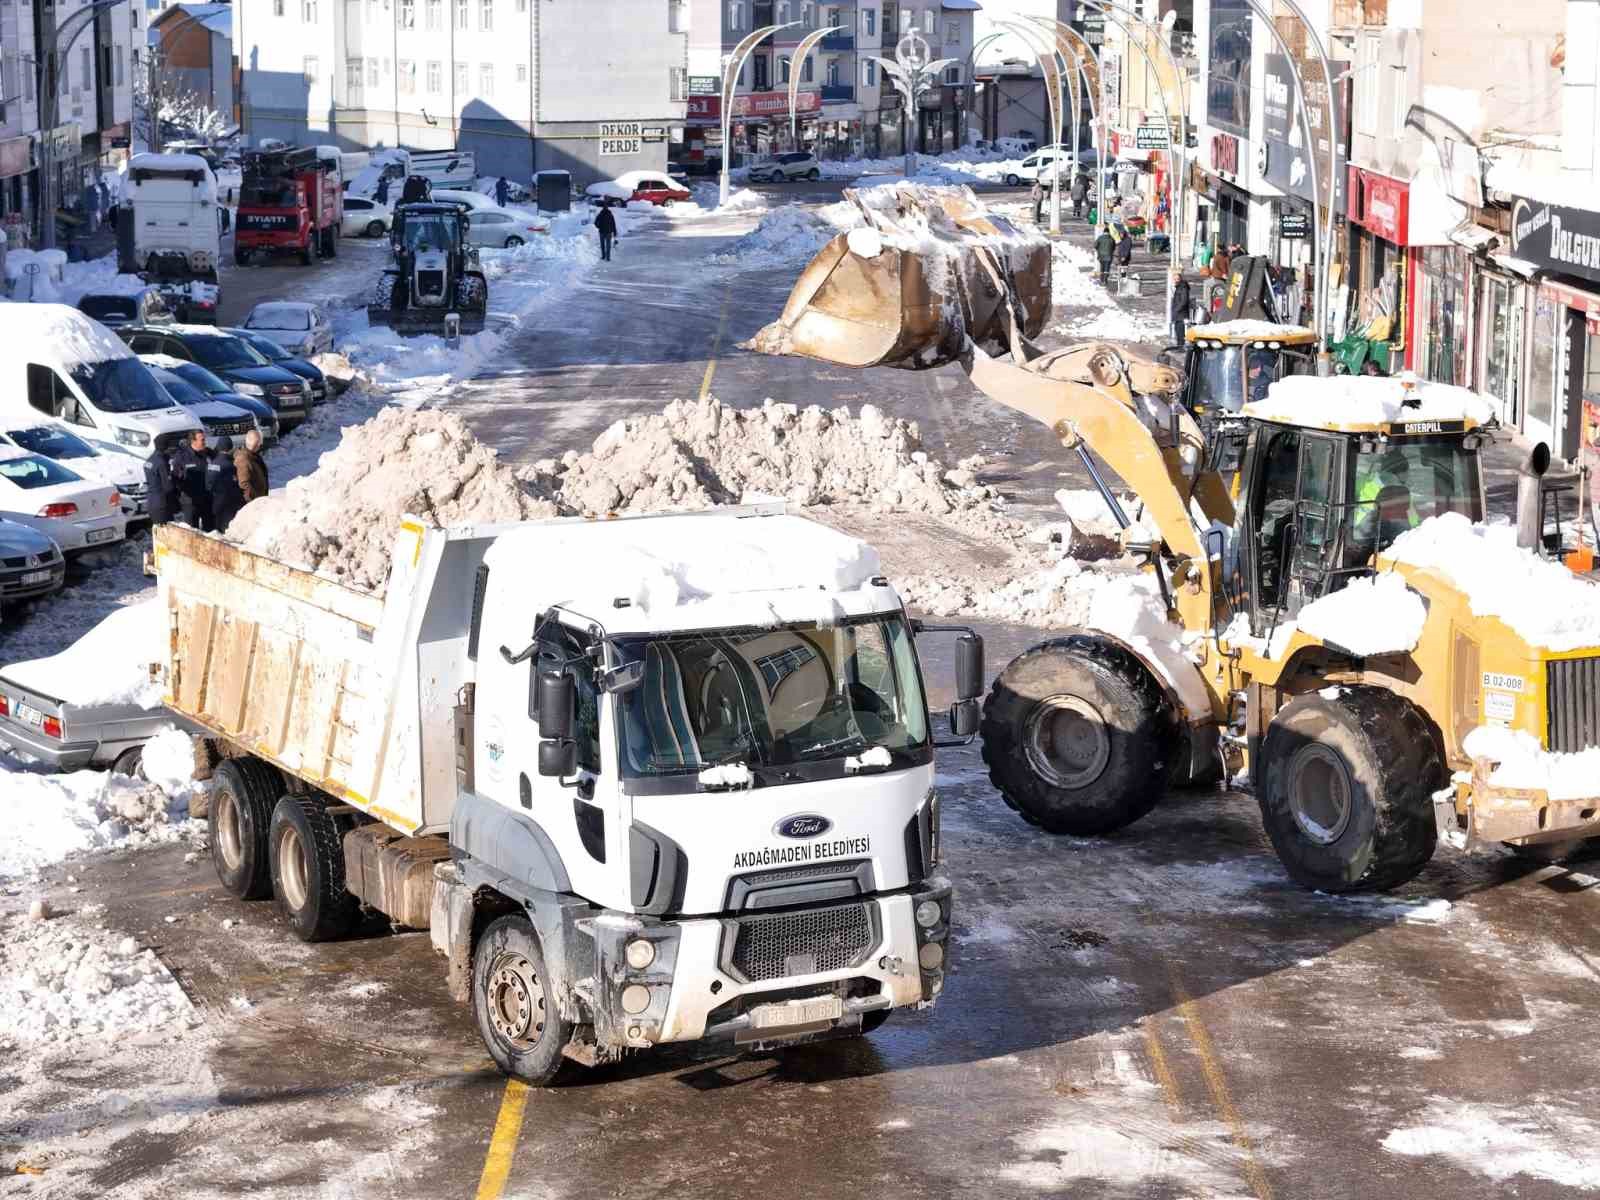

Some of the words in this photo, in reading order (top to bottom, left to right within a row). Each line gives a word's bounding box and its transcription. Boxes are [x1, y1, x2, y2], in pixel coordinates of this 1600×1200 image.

[602, 124, 639, 136] DEKOR
[1138, 128, 1168, 139] AVUKA
[602, 140, 639, 153] PERDE
[791, 819, 820, 834] Ford
[734, 842, 812, 868] AKDAĞMADENİ
[815, 834, 870, 860] BELEDİYESİ
